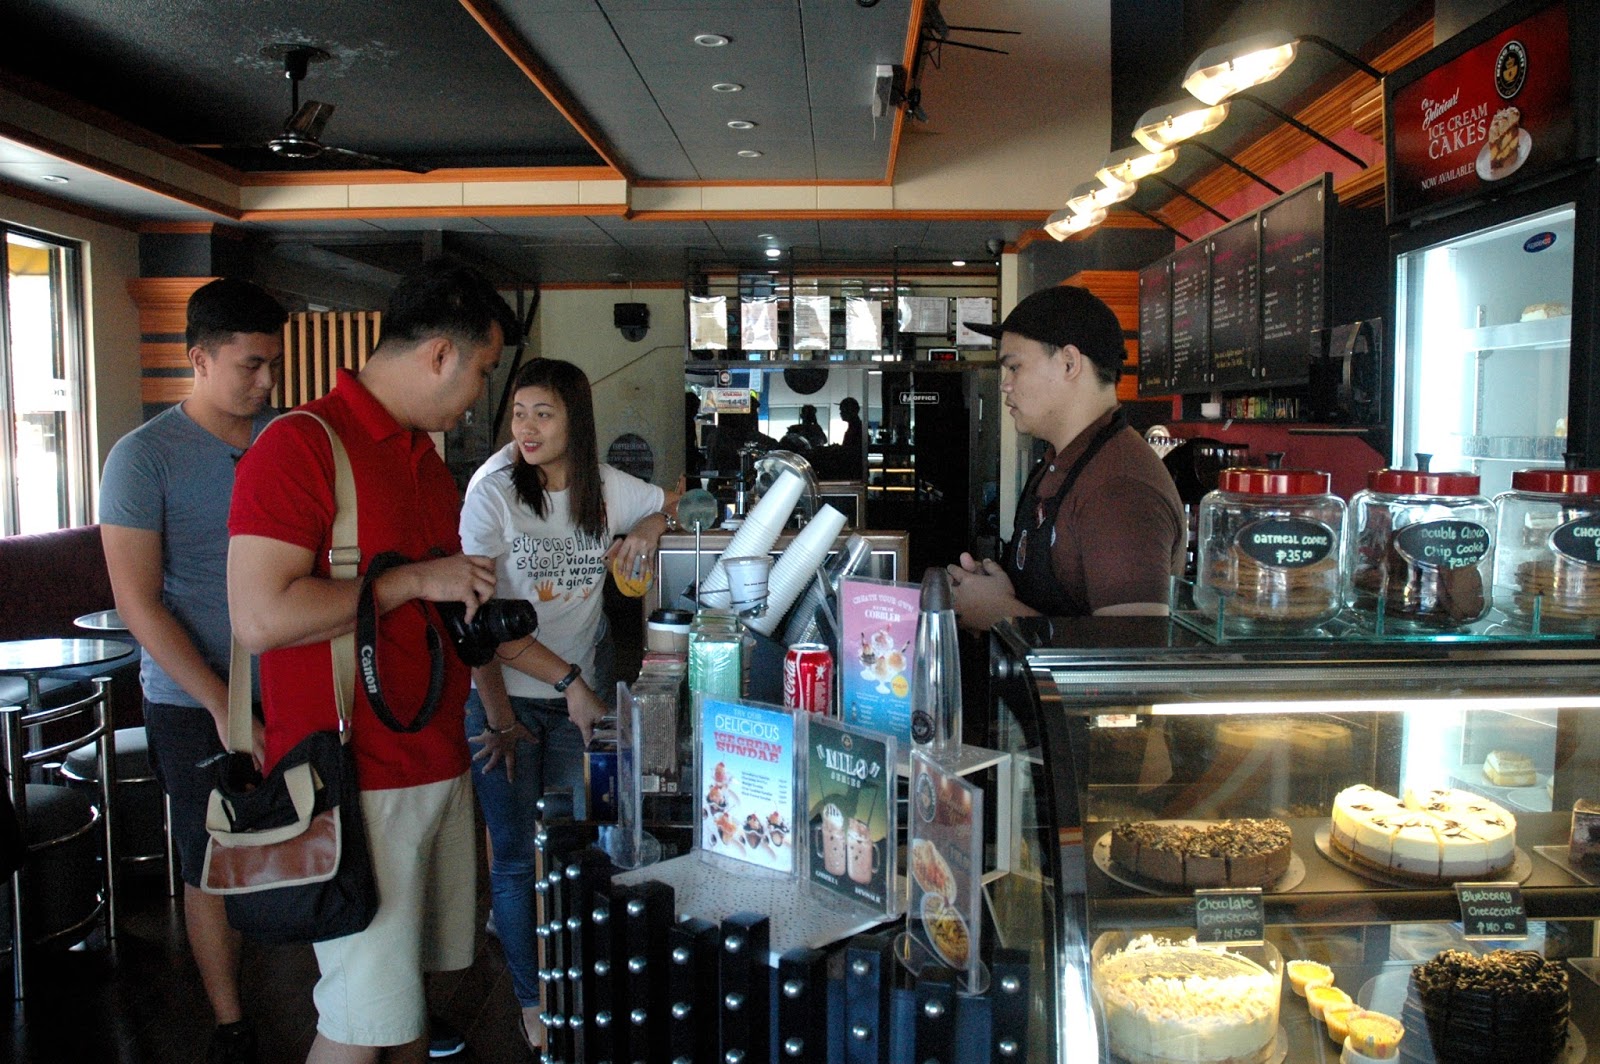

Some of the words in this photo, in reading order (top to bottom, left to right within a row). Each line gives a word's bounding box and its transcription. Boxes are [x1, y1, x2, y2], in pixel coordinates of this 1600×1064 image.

[1428, 123, 1445, 141] ICE
[1447, 102, 1488, 132] CREAM
[1428, 119, 1487, 160] CAKES
[1421, 175, 1437, 191] NOW
[1421, 527, 1457, 539] Double
[527, 568, 566, 580] against
[557, 577, 564, 586] &
[566, 577, 593, 590] girls
[878, 594, 896, 605] YOUR
[864, 609, 901, 622] COBBLER
[361, 645, 378, 694] Canon
[715, 714, 780, 742] DELICIOUS
[714, 731, 735, 742] ICE
[736, 735, 783, 754] CREAM
[716, 741, 779, 764] SUNDAE
[830, 771, 861, 789] SERIES
